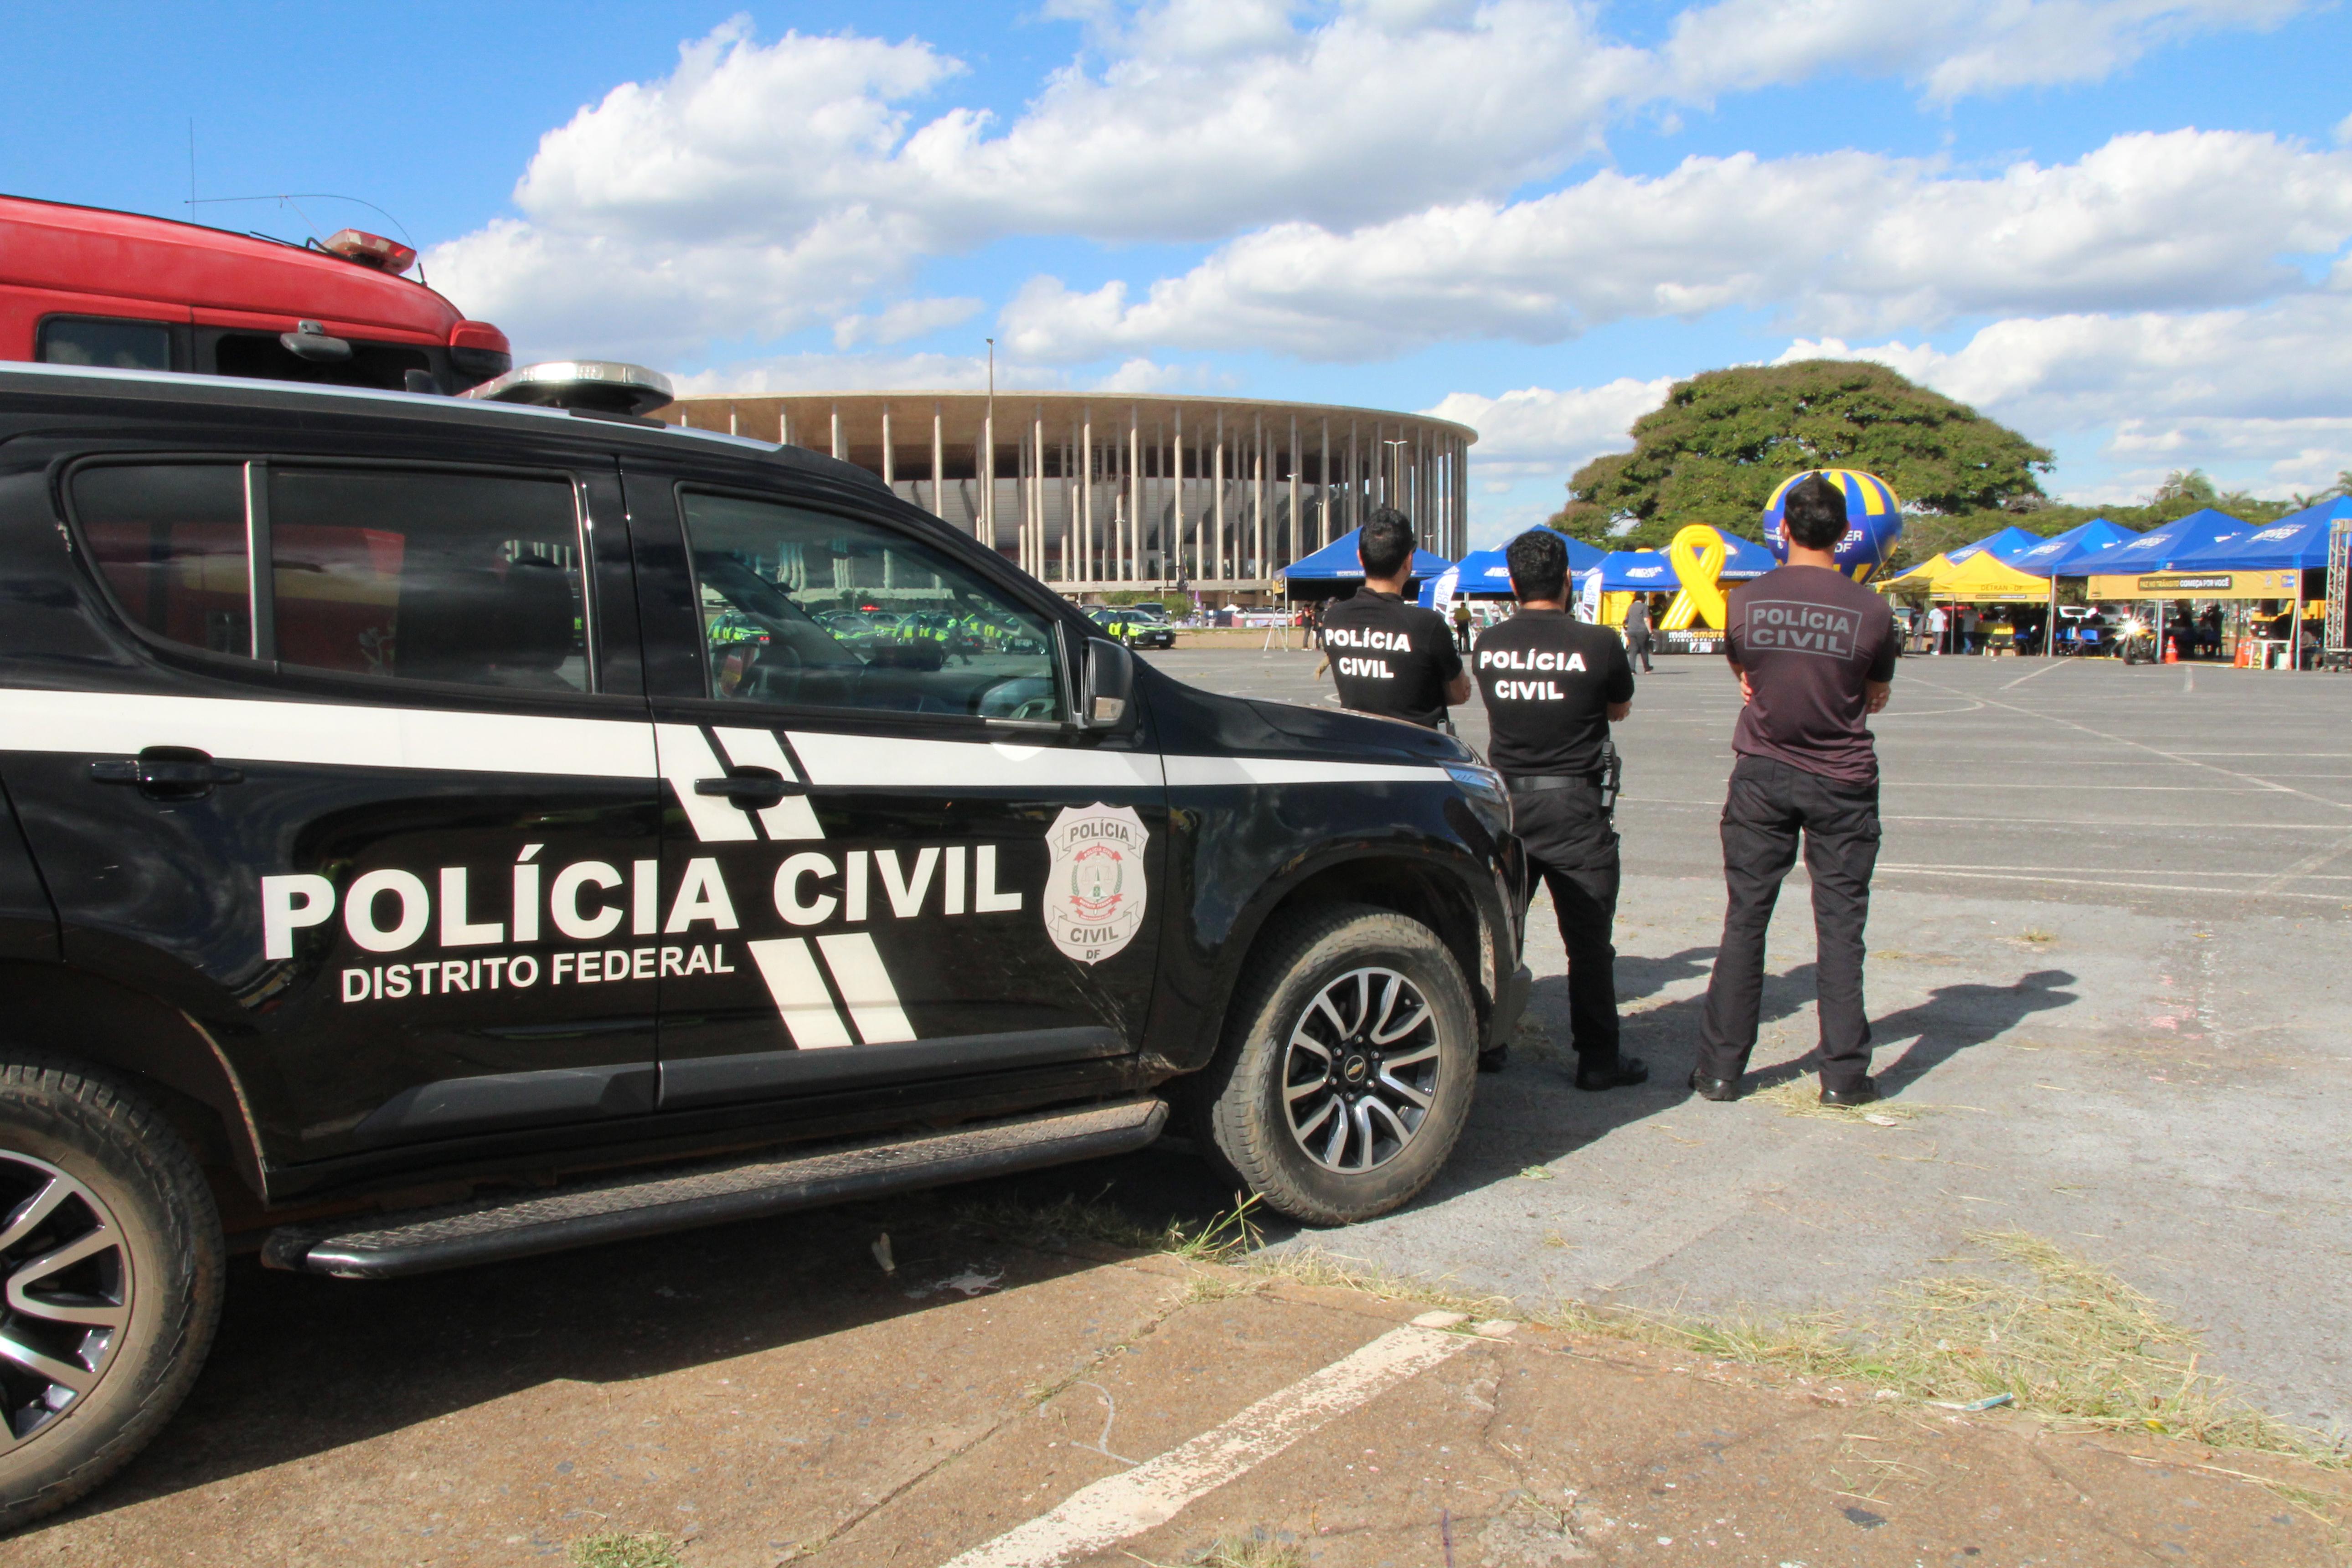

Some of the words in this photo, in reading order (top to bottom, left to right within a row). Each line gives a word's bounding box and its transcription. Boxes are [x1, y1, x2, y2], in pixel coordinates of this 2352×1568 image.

[1834, 543, 1853, 552] DF
[1844, 531, 1863, 542] ER
[2180, 579, 2202, 588] COMEÇA
[2214, 577, 2229, 587] VOCÊ
[1753, 608, 1850, 634] POLÍCIA
[1325, 627, 1411, 652] POLÍCIA
[1752, 629, 1847, 654] CIVIL
[1339, 657, 1394, 678] CIVIL
[1480, 648, 1587, 671] POLÍCIA
[1495, 680, 1564, 700] CIVIL
[1070, 819, 1130, 842] POLÍCIA
[262, 843, 739, 960] POLÍCIA
[774, 845, 1022, 926] CIVIL
[1070, 927, 1119, 943] CIVIL
[1086, 949, 1101, 959] DF
[343, 955, 538, 1003] DISTRITO
[552, 944, 735, 985] FEDERAL
